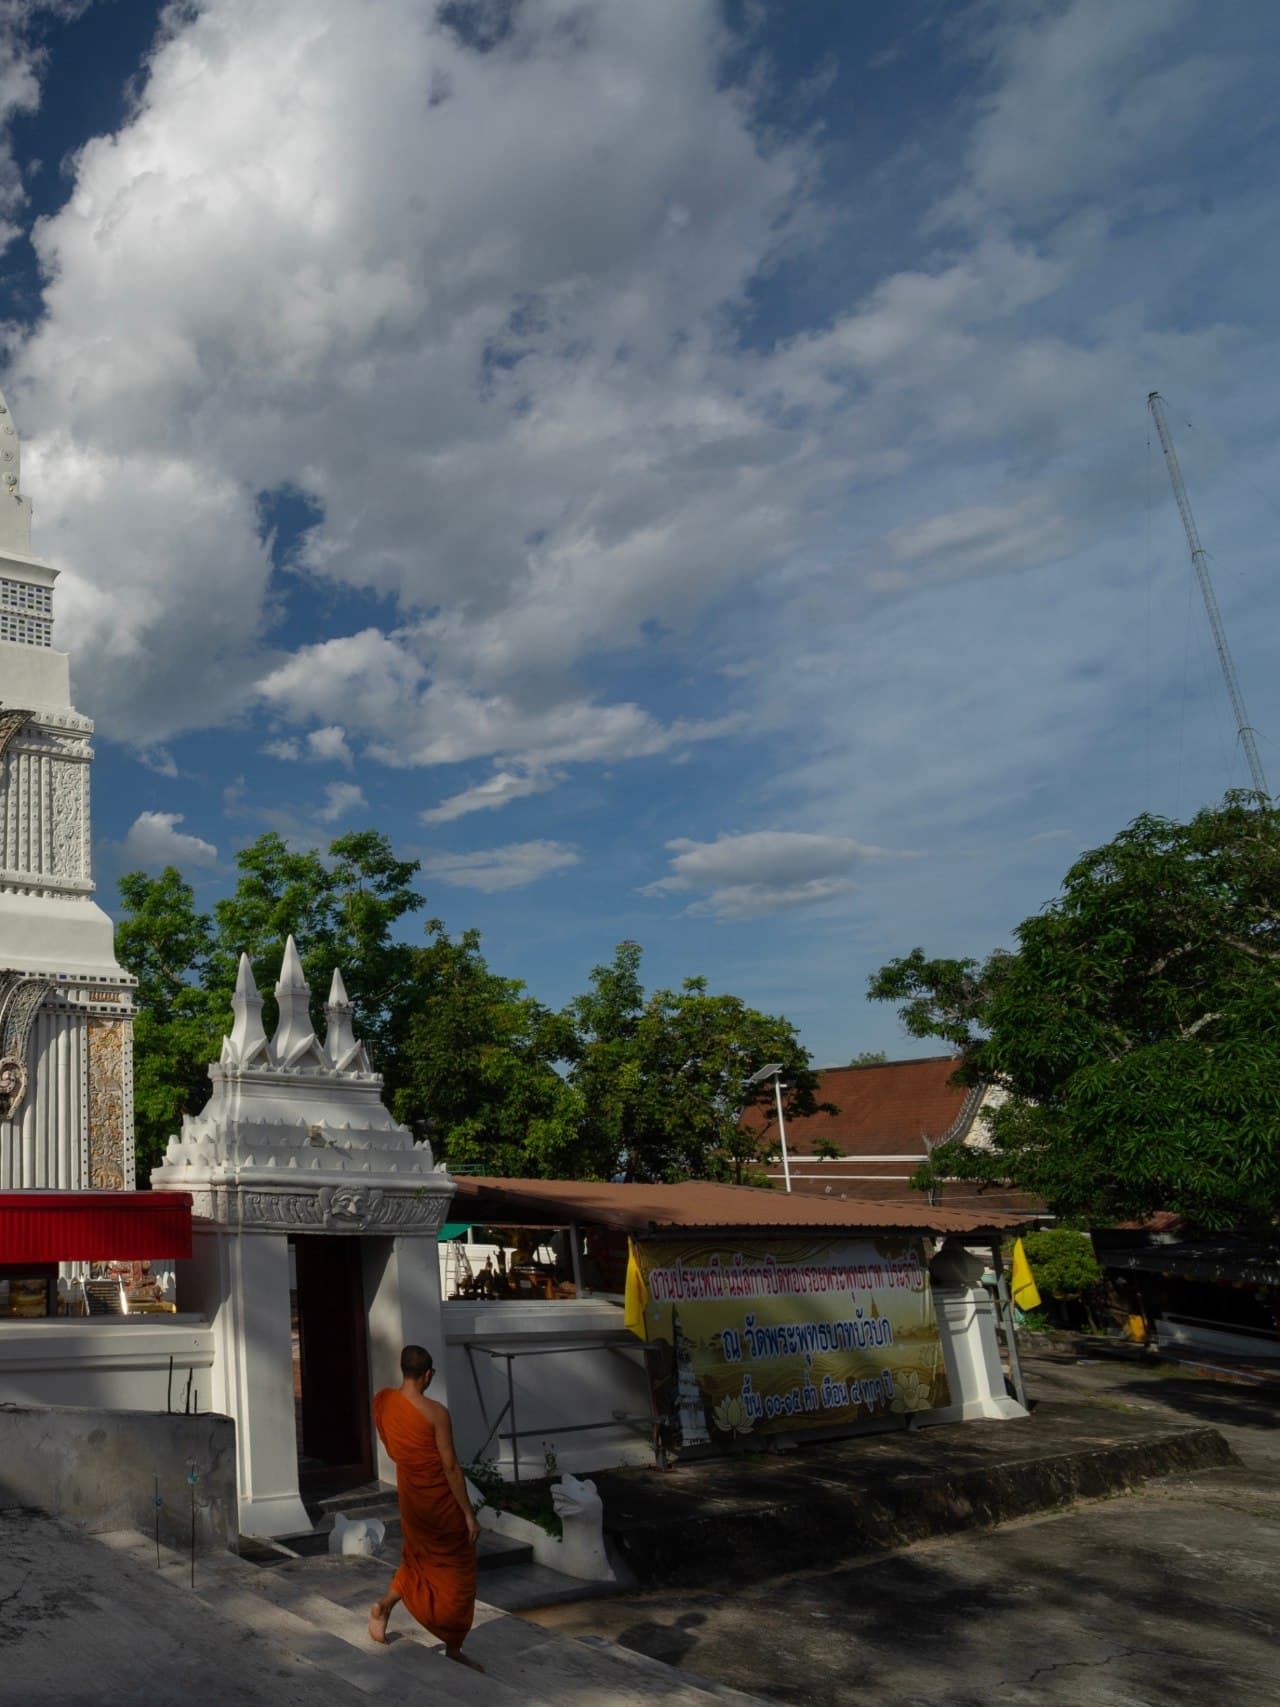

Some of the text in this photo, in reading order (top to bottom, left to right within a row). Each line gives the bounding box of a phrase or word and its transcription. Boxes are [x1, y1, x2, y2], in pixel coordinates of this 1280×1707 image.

[650, 1256, 723, 1301] งานประเพณี
[723, 1308, 892, 1366] ณ วัดพระพุทธบาทบัวบก
[744, 1376, 762, 1417] ขึ้น
[804, 1372, 819, 1409] ค่ำ
[822, 1377, 849, 1405] เดือน
[882, 1371, 896, 1398] ปี
